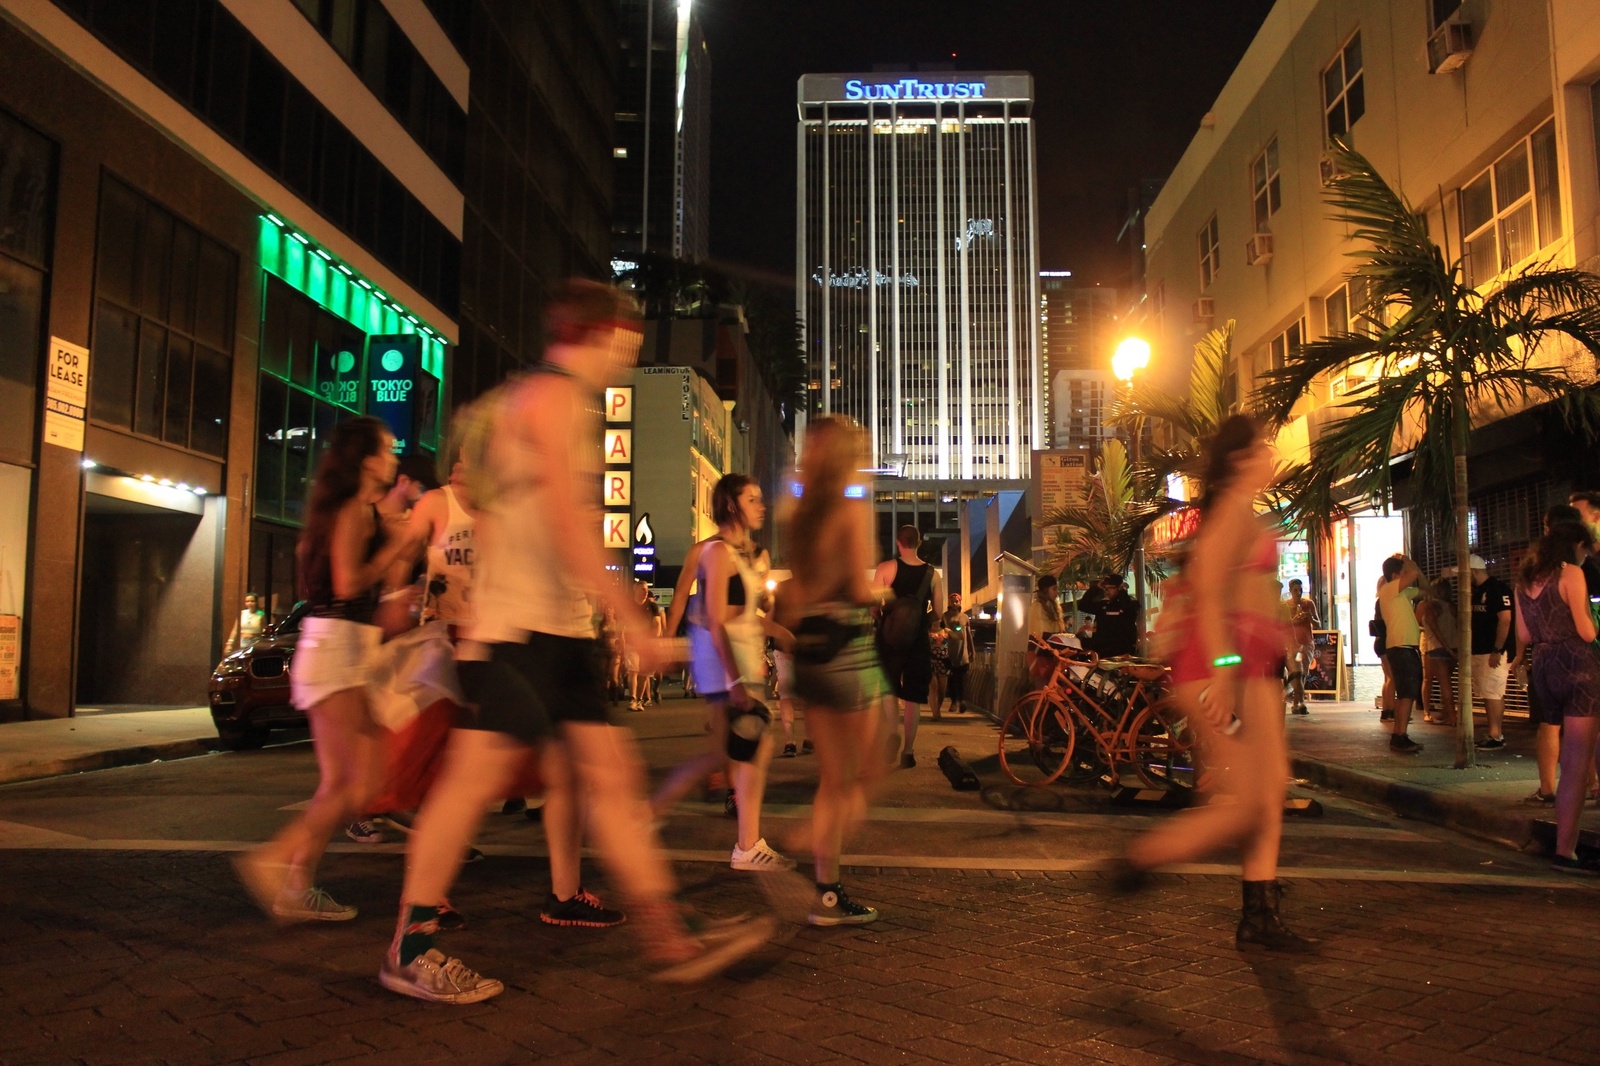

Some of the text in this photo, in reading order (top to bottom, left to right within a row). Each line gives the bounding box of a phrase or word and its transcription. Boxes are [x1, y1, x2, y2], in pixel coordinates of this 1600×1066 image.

[57, 349, 79, 368] FOR
[50, 363, 84, 387] LEASE
[371, 380, 413, 391] TOKYO
[376, 391, 407, 402] BLUE
[610, 393, 627, 543] PARK
[1502, 595, 1512, 607] 5
